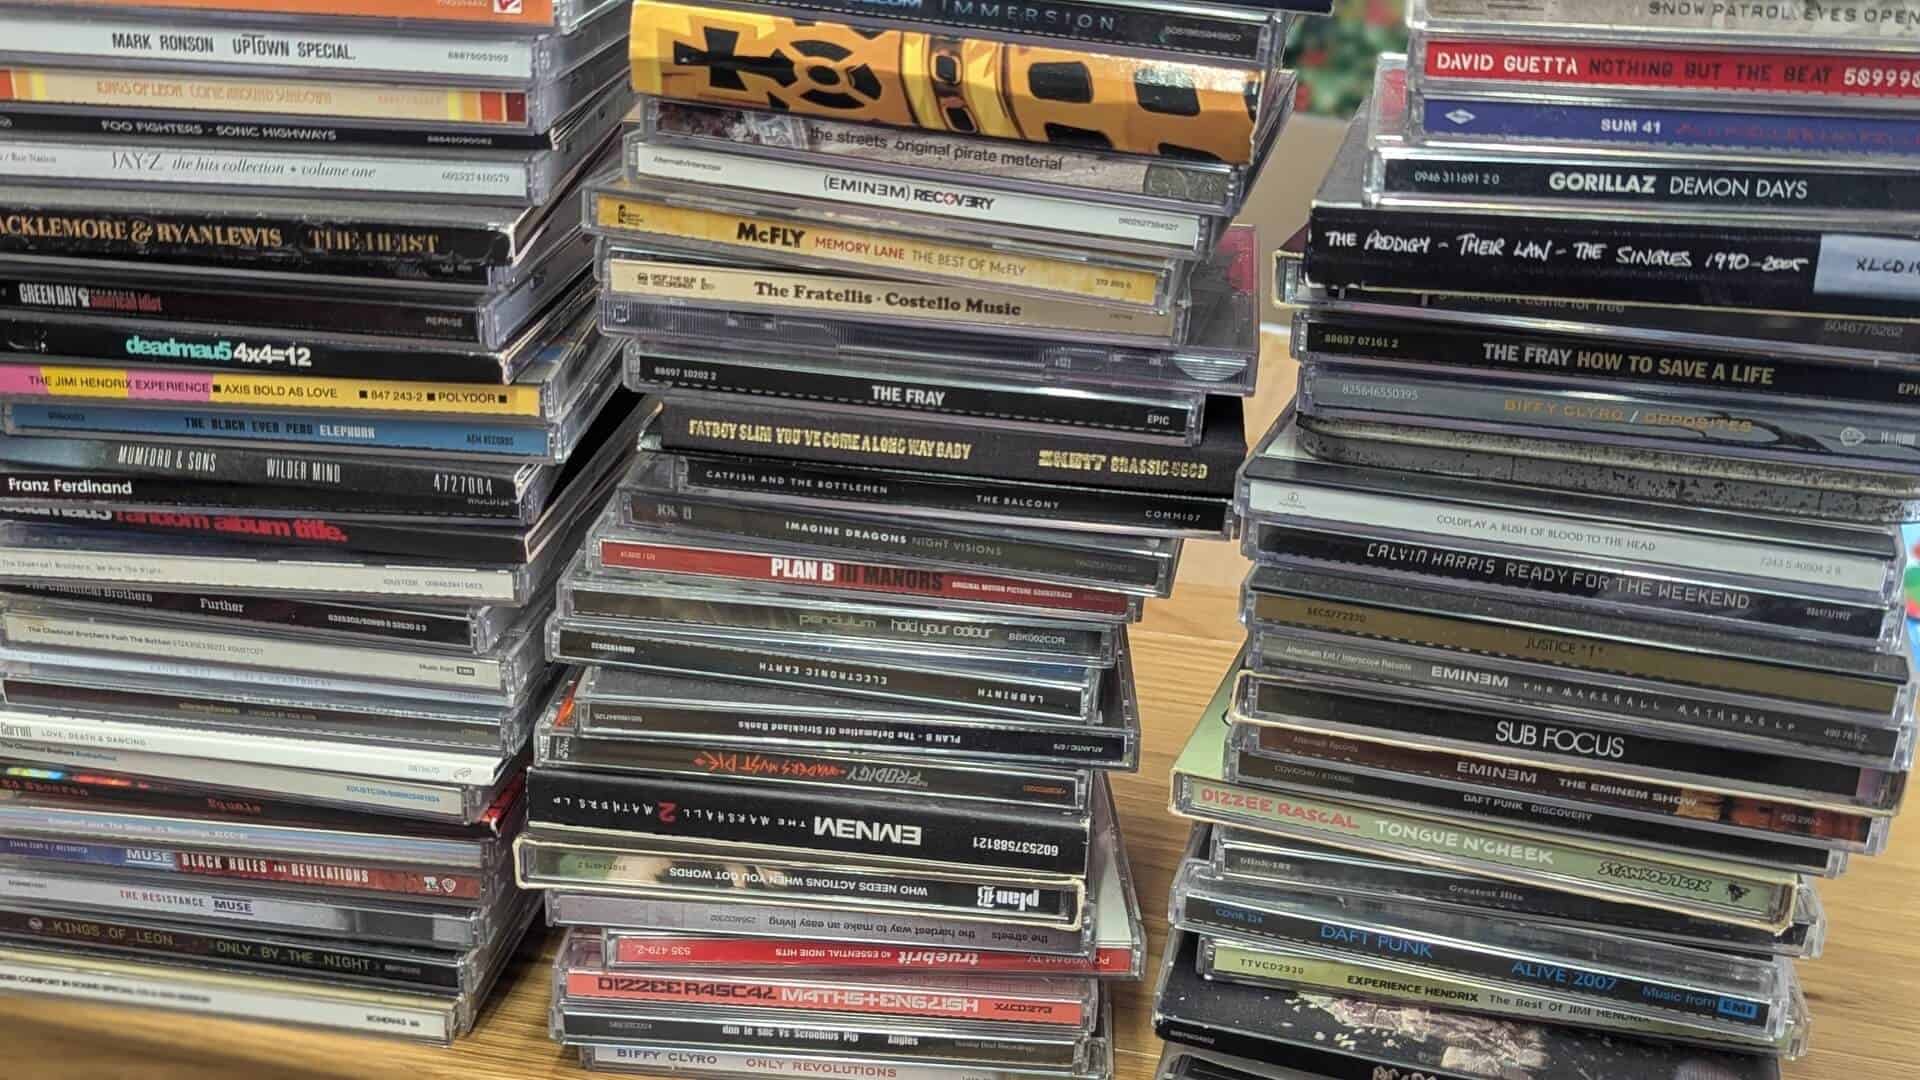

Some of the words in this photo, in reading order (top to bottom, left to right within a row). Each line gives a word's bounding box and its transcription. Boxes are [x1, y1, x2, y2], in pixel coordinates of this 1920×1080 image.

[942, 0, 1114, 31] IMMERSION
[1648, 2, 1706, 16] SNOW
[1804, 7, 1856, 22] EYES
[112, 33, 151, 49] MARK
[160, 36, 214, 53] RONSON
[1436, 52, 1494, 71] DAVID
[1504, 55, 1578, 75] GUETTA
[1589, 59, 1673, 78] NOTHING
[1685, 62, 1722, 79] BUT
[1736, 63, 1770, 81] THE
[1783, 65, 1833, 82] BEAT
[101, 121, 132, 132] FOO
[136, 122, 202, 135] FIGHTERS
[216, 126, 259, 137] SONIC
[262, 128, 336, 140] HIGHWAYS
[1601, 118, 1638, 133] SUM
[1642, 120, 1661, 134] 41
[810, 128, 833, 140] the
[837, 130, 888, 149] streets
[894, 139, 950, 161] original
[954, 146, 997, 163] pirate
[1001, 153, 1063, 170] material
[172, 158, 192, 170] the
[196, 159, 220, 173] hits
[222, 161, 284, 174] collection
[301, 166, 350, 176] volume
[352, 169, 376, 177] one
[1549, 172, 1656, 193] GORILLAZ
[1669, 177, 1751, 197] DEMON
[1755, 179, 1808, 198] DAYS
[737, 222, 805, 248] McFLY
[815, 237, 870, 255] MEMORY
[874, 243, 904, 260] LANE
[912, 250, 936, 264] THE
[938, 253, 965, 268] BEST
[968, 257, 984, 271] OF
[989, 261, 1027, 276] McFLY
[1325, 231, 1356, 247] THE
[1456, 234, 1504, 256] THEIR
[1513, 239, 1552, 262] LAW
[1573, 243, 1606, 260] THE
[754, 281, 788, 298] The
[794, 284, 873, 304] Fratellis
[885, 292, 961, 312] Costello
[966, 298, 1022, 316] Music
[126, 335, 232, 360] deadmau5
[1484, 343, 1520, 361] THE
[1525, 347, 1574, 366] FRAY
[1577, 349, 1624, 370] HOW
[1628, 354, 1653, 373] TO
[1658, 357, 1707, 378] SAVE
[1712, 364, 1726, 380] A
[1731, 367, 1774, 384] LIFE
[30, 375, 51, 386] THE
[55, 377, 77, 388] JIMI
[81, 378, 132, 390] HENDRIX
[135, 380, 209, 393] EXPERIENCE
[224, 385, 251, 396] AXIS
[254, 386, 284, 397] BOLD
[287, 387, 303, 398] AS
[306, 388, 337, 399] LOVE
[437, 393, 496, 404] POLYDOR
[872, 385, 902, 401] THE
[905, 388, 945, 406] FRAY
[689, 419, 737, 439] FATBOY
[739, 423, 772, 443] SLIM
[118, 445, 171, 468] MUMFORD
[188, 453, 216, 472] SONS
[266, 458, 307, 480] WILDER
[313, 463, 341, 483] MIND
[8, 478, 50, 492] Franz
[54, 478, 132, 495] Ferdinand
[706, 470, 756, 482] CATFISH
[760, 474, 785, 484] AND
[790, 477, 812, 487] THE
[817, 479, 888, 494] BOTTLEMEN
[976, 494, 999, 504] THE
[1003, 497, 1060, 509] BALCONY
[215, 514, 290, 537] album
[295, 518, 347, 542] title.
[785, 521, 840, 535] IMAGINE
[845, 529, 907, 544] DRAGONS
[1530, 527, 1546, 538] OF
[1548, 529, 1585, 542] BLOOD
[1626, 540, 1656, 552] HEAD
[771, 557, 818, 579] PLAN
[821, 562, 834, 581] B
[1366, 543, 1428, 563] CALVIN
[1431, 551, 1496, 574] HARRIS
[1504, 564, 1567, 583] READY
[1572, 570, 1610, 589] FOR
[1614, 577, 1652, 596] THE
[1657, 584, 1751, 610] WEEKEND
[200, 599, 244, 613] Further
[890, 617, 919, 632] hold
[920, 623, 948, 635] your
[1525, 635, 1577, 654] JUSTICE
[806, 667, 888, 684] ELECTRONIC
[1523, 681, 1554, 694] THE
[935, 734, 960, 744] PLAN
[1494, 721, 1537, 745] SUB
[1544, 727, 1625, 759] FOCUS
[1558, 778, 1587, 790] THE
[1652, 792, 1698, 808] SHOW
[659, 802, 676, 822] 2
[1201, 787, 1273, 814] DIZZEE
[1277, 802, 1360, 830] RASCAL
[1374, 820, 1458, 848] TONGUE
[1463, 793, 1491, 807] DAFT
[1494, 797, 1523, 811] PUNK
[1530, 803, 1593, 821] DISCOVERY
[973, 836, 1059, 856] 602537588121
[182, 853, 222, 869] BLACK
[291, 863, 369, 883] REVELATIONS
[670, 867, 709, 879] WORDS
[806, 878, 856, 892] ACTIONS
[859, 882, 897, 894] NEEDS
[899, 885, 928, 896] WHO
[120, 889, 138, 900] THE
[214, 900, 252, 912] MUSE
[997, 889, 1040, 910] plan
[873, 924, 888, 934] to
[890, 925, 913, 935] way
[915, 926, 956, 939] hardest
[958, 929, 976, 939] the
[53, 921, 100, 936] KINGS
[109, 926, 126, 939] OF
[137, 930, 174, 945] LEON
[216, 941, 251, 955] ONLY
[261, 945, 280, 959] BY
[288, 949, 313, 961] THE
[324, 953, 370, 971] NIGHT
[775, 948, 798, 957] HITS
[800, 948, 827, 957] INDIE
[829, 949, 881, 959] ESSENTIAL
[1320, 924, 1369, 945] DAFT
[1377, 935, 1433, 960] PUNK
[1512, 961, 1567, 983] ALIVE
[1573, 971, 1617, 992] 2007
[1347, 975, 1422, 995] EXPERIENCE
[1425, 986, 1479, 1003] HENDRIX
[1489, 994, 1510, 1006] The
[617, 1048, 660, 1062] BIFFY
[668, 1051, 717, 1065] CLYRO
[746, 1057, 786, 1070] ONLY
[792, 1060, 897, 1078] REVOLUTIONS
